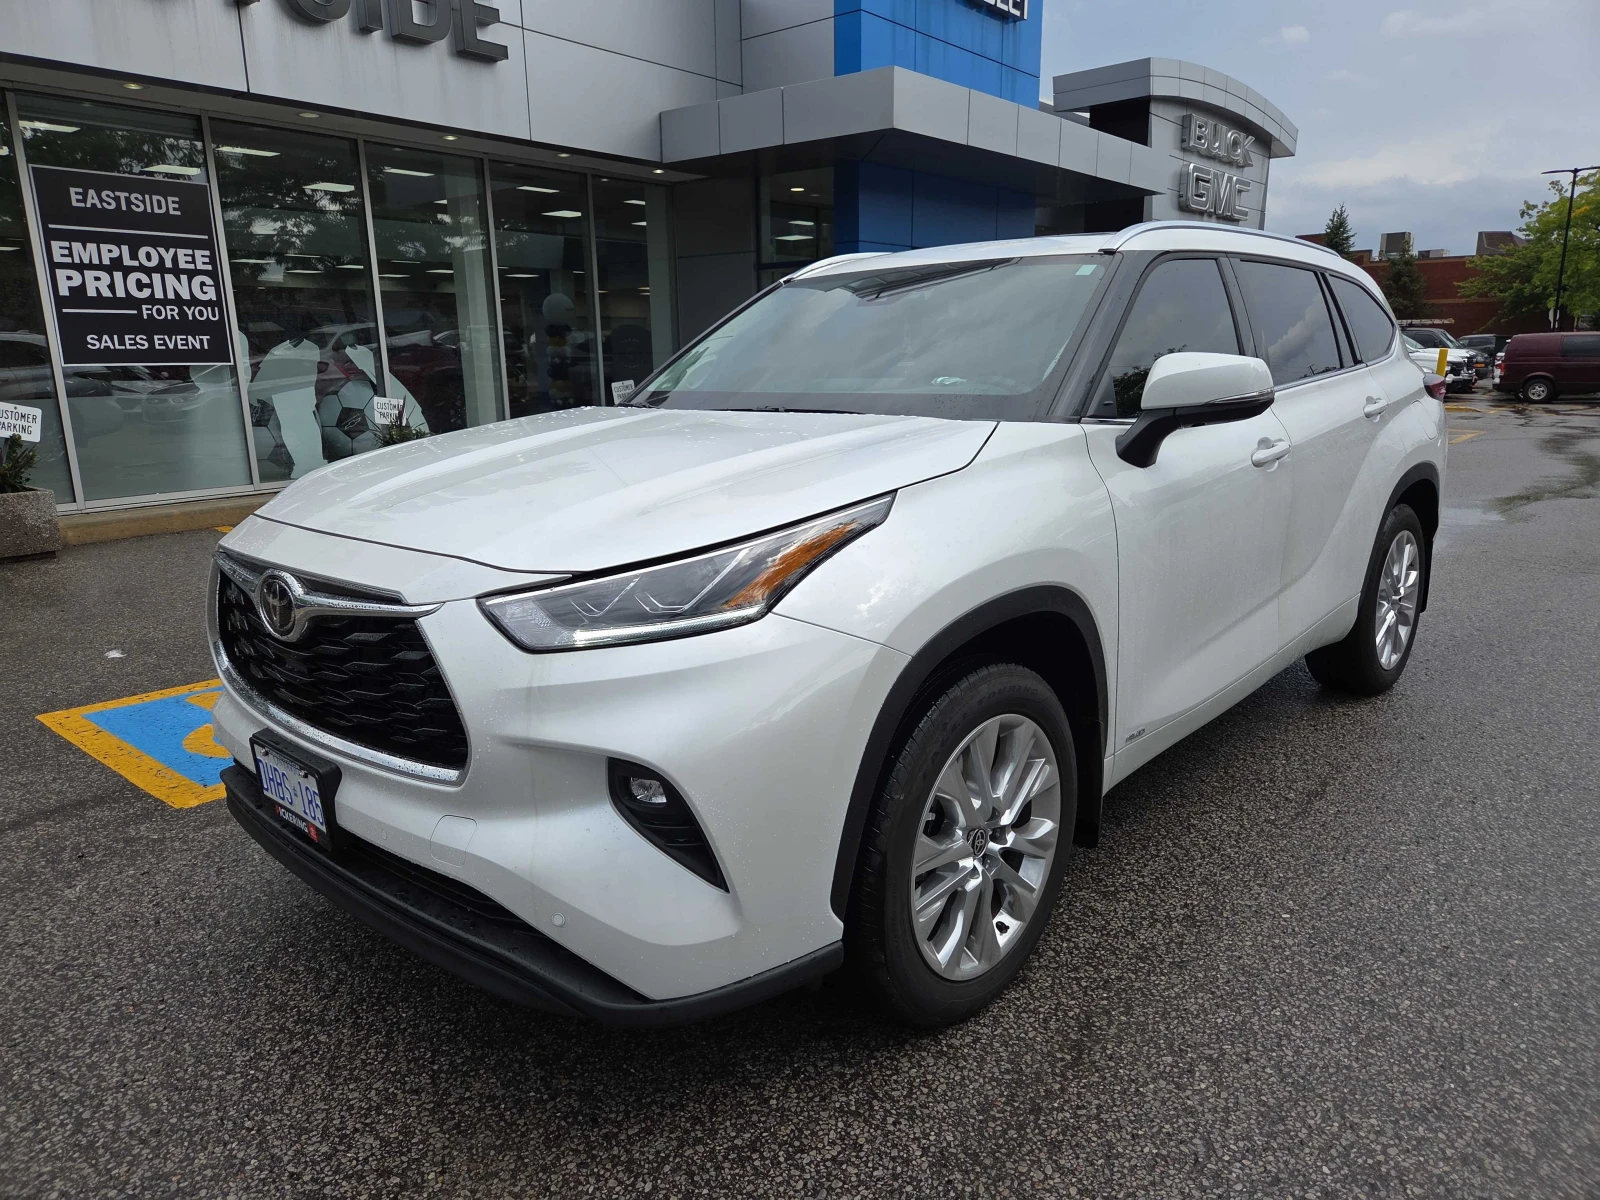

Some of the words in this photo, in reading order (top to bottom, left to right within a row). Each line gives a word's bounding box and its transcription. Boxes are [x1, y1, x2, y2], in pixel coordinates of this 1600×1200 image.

[1184, 113, 1255, 167] BUICK
[69, 187, 181, 215] EASTSIDE
[1182, 162, 1251, 220] GMC
[50, 240, 213, 270] EMPLOYEE
[55, 268, 217, 301] PRICING
[141, 304, 179, 320] FOR
[183, 306, 219, 321] YOU
[86, 335, 149, 350] SALES
[153, 335, 210, 350] EVENT
[376, 401, 404, 411] CUSTOM
[379, 411, 399, 421] PARKI
[0, 421, 33, 435] ARKING
[256, 757, 294, 806] DHBS
[297, 780, 325, 827] 185
